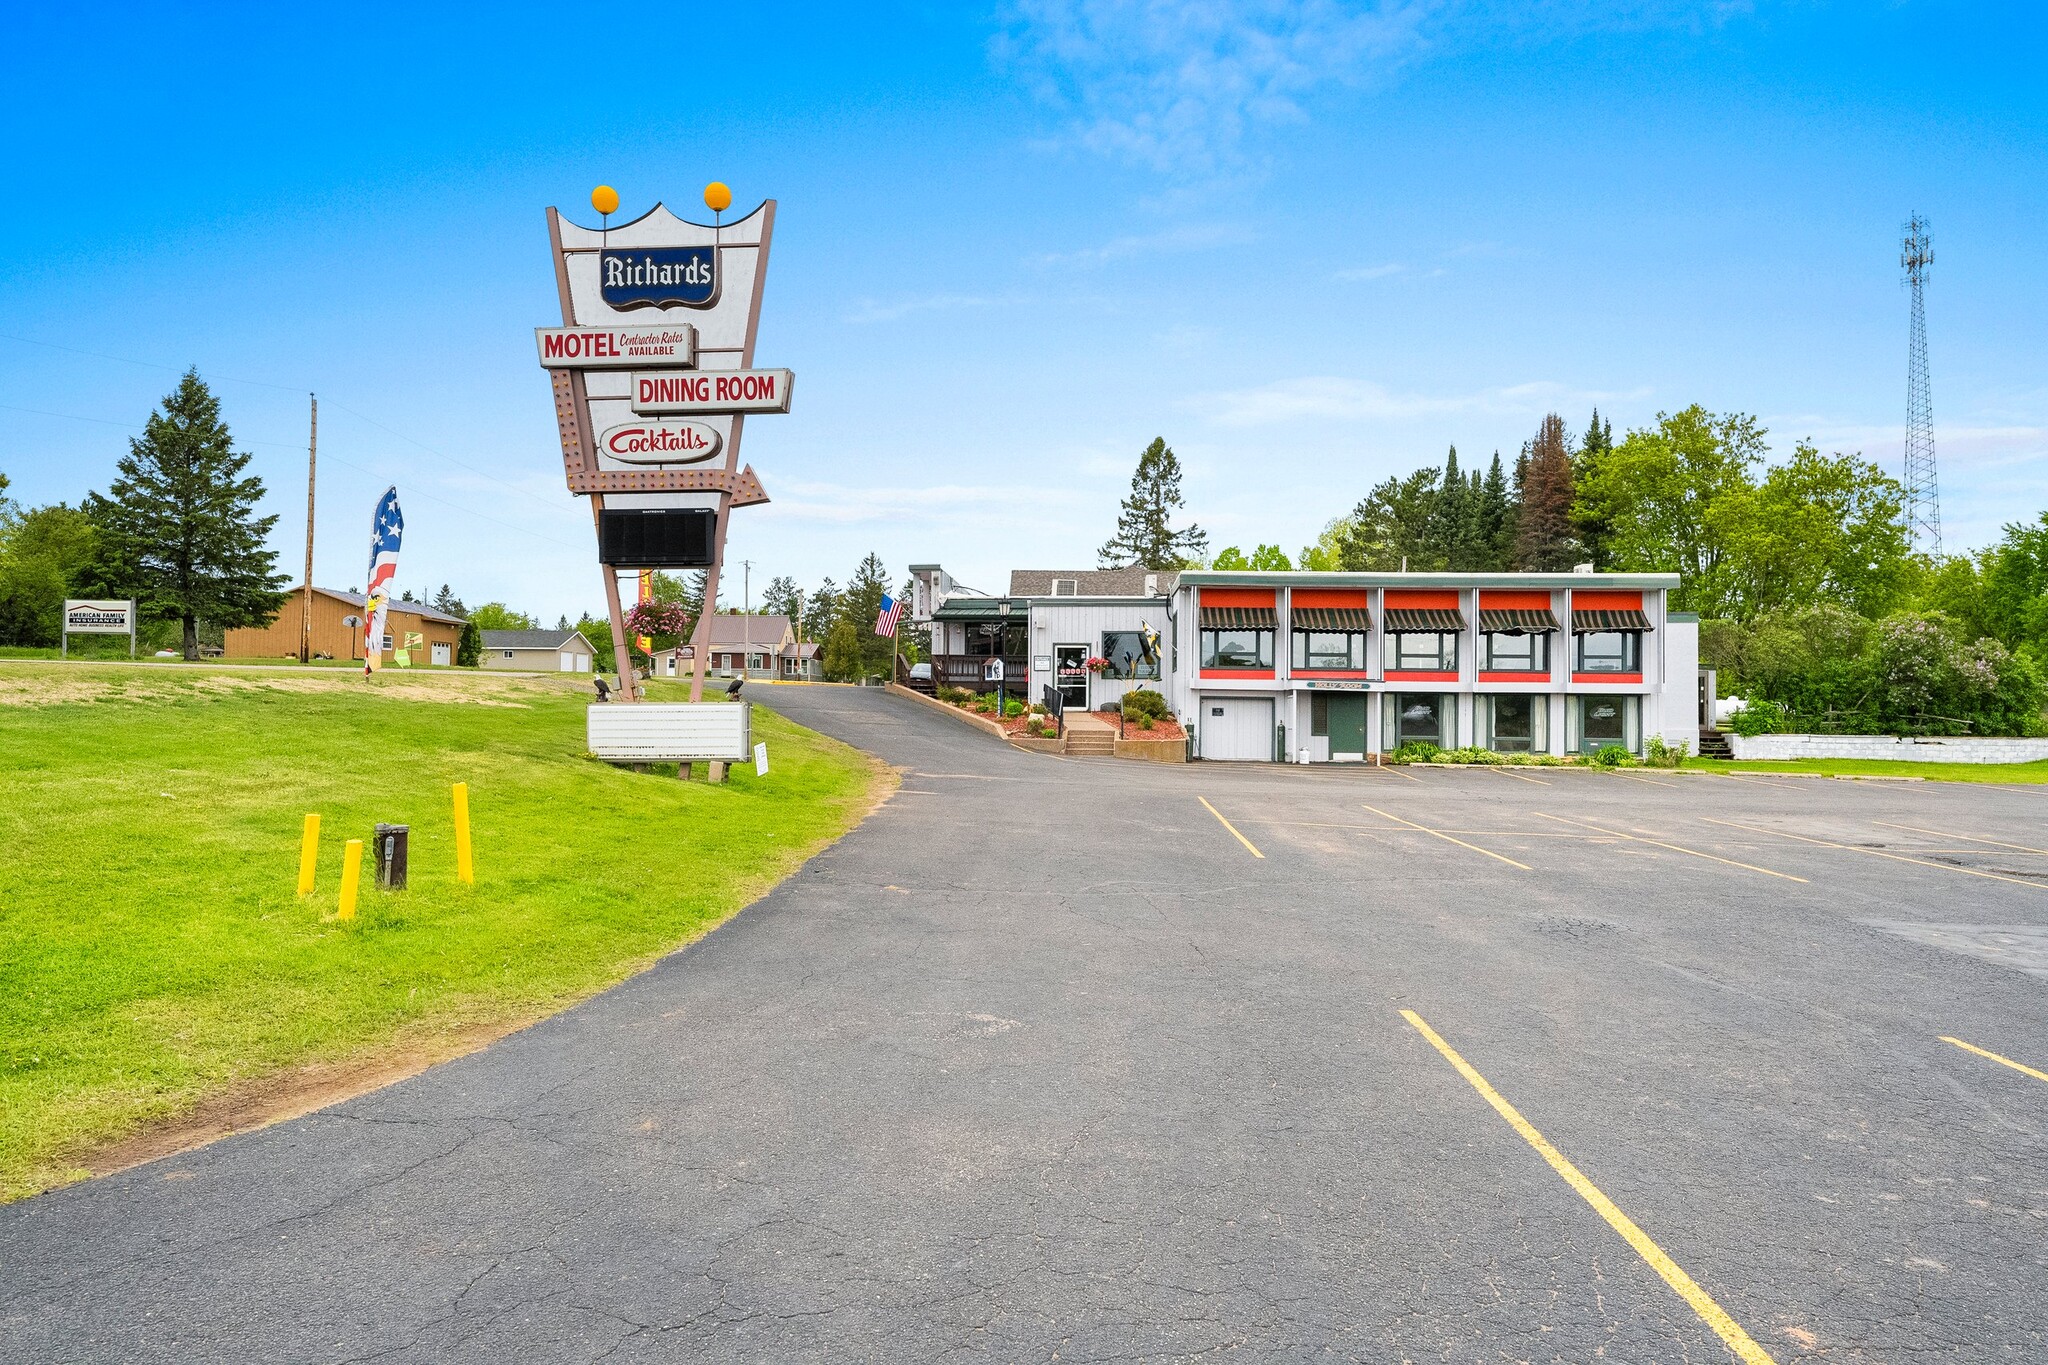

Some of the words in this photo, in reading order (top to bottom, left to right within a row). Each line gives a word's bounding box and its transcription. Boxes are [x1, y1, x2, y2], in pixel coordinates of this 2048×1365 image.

[604, 255, 711, 287] Richards
[544, 333, 621, 358] MOTEL
[620, 333, 660, 346] Contractor
[660, 331, 683, 343] Rates
[628, 345, 675, 356] AVAILABLE
[639, 377, 709, 403] DINING
[716, 375, 775, 401] ROOM
[609, 427, 709, 454] Cocktails
